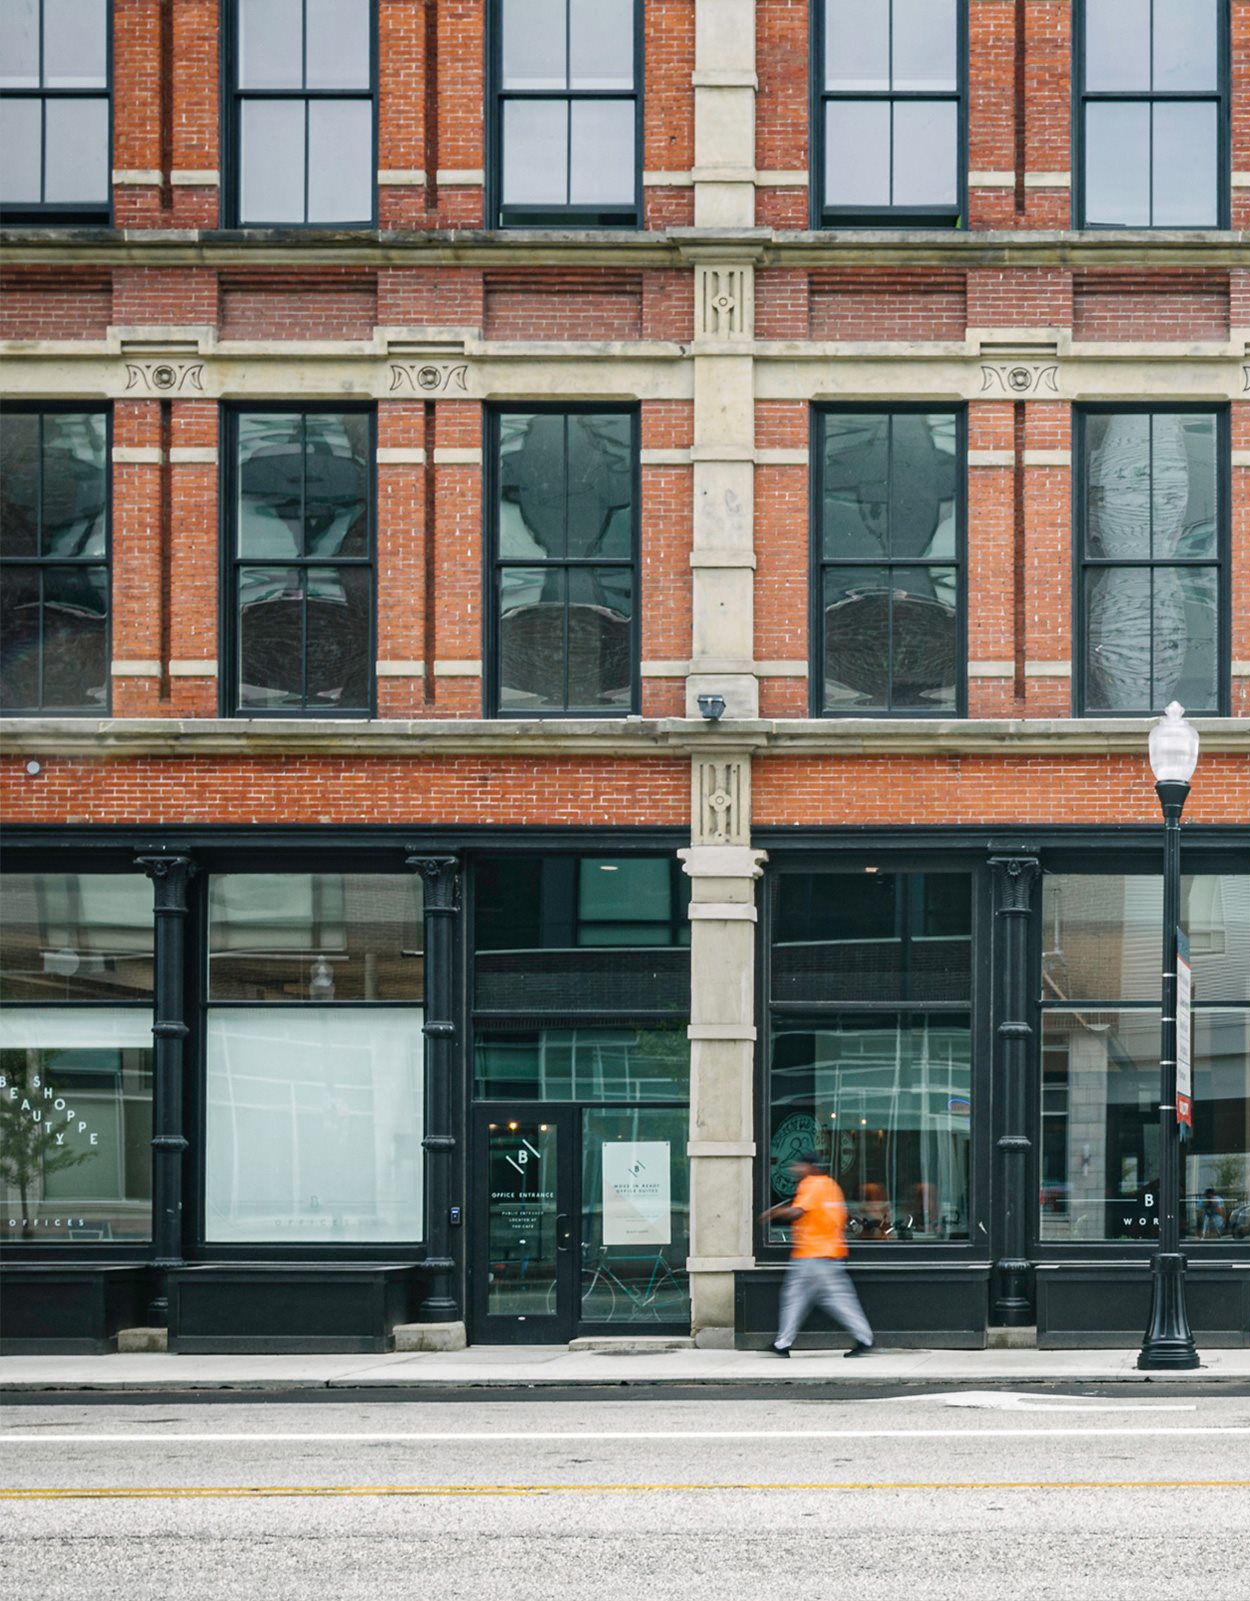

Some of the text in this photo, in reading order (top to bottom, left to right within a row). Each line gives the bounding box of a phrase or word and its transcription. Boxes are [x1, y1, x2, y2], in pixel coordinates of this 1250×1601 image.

[0, 1075, 65, 1145] BEAUTY
[33, 1075, 99, 1145] SHOPPE
[518, 1150, 528, 1164] B
[1144, 1194, 1154, 1207] B
[9, 1219, 84, 1227] OFFICES
